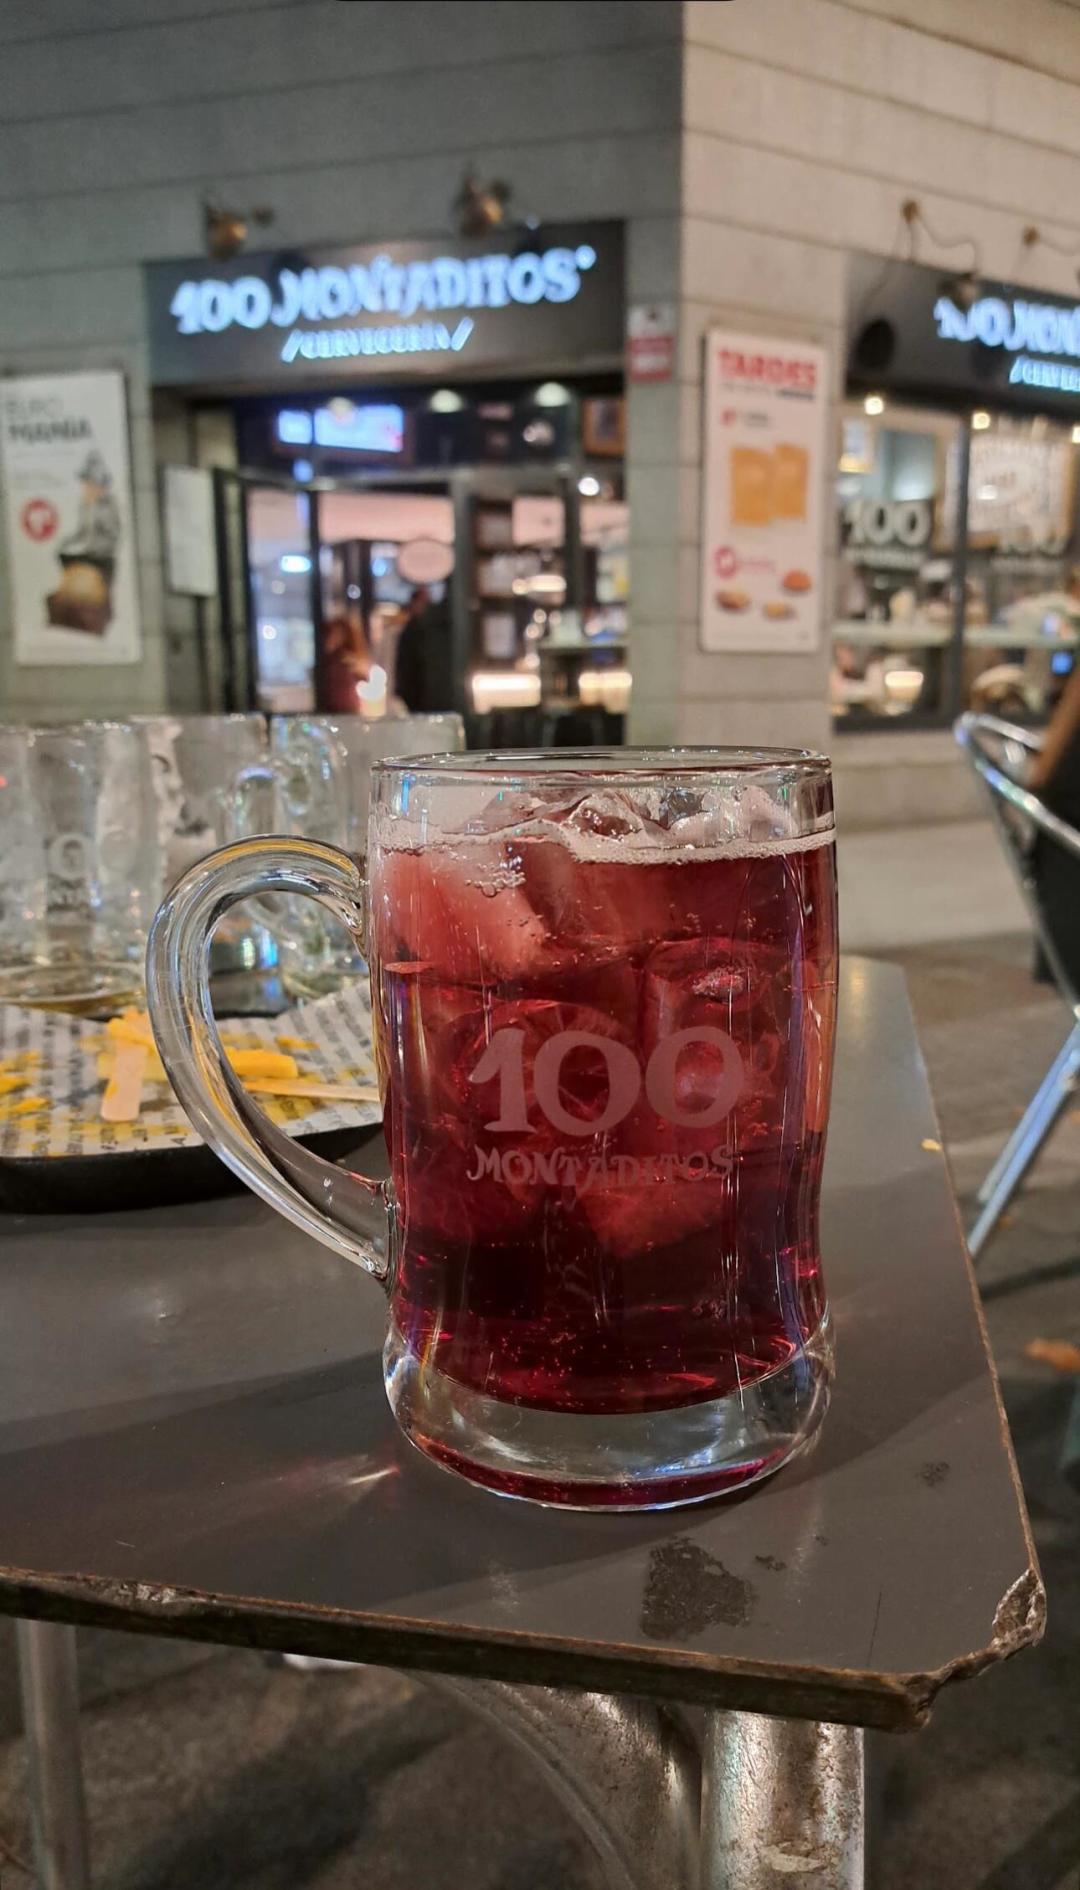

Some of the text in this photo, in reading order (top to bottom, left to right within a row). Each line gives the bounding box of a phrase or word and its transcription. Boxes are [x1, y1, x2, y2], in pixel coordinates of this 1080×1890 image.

[169, 246, 582, 334] 100 MONTADITOS
[467, 1026, 744, 1136] 100
[466, 1144, 735, 1198] MONTADITOS
